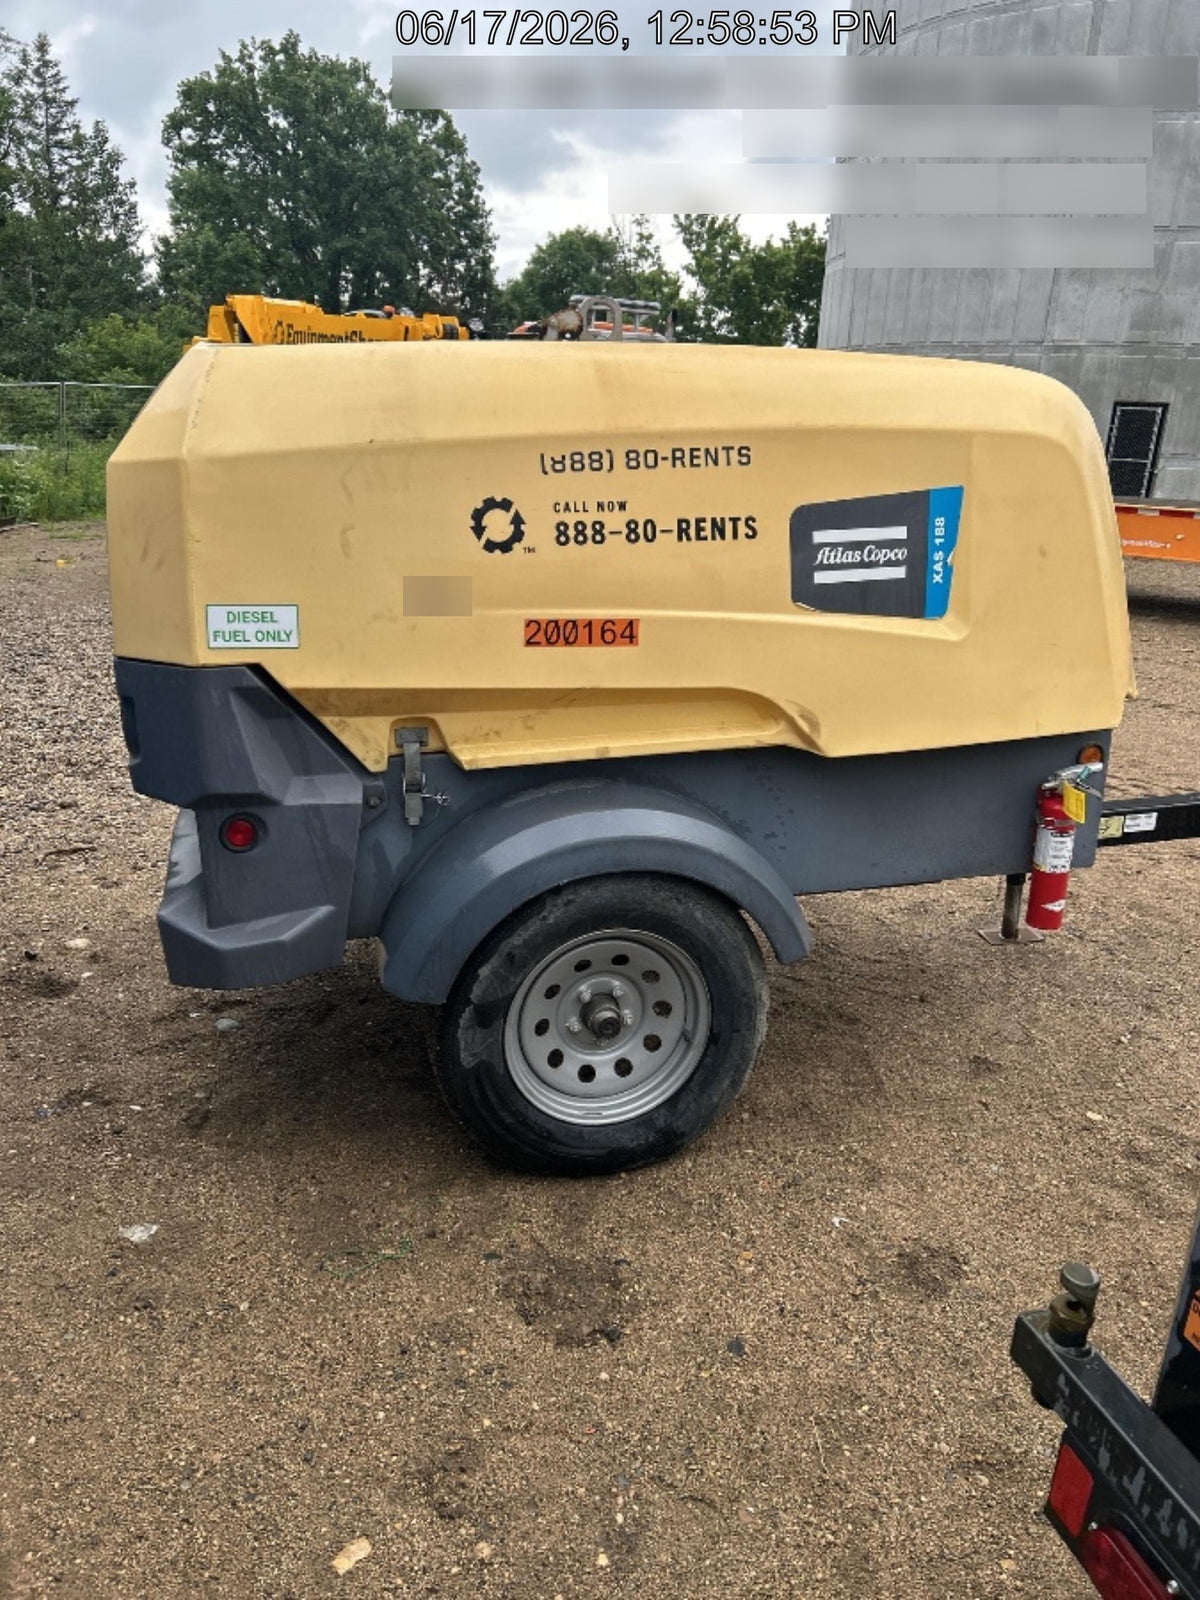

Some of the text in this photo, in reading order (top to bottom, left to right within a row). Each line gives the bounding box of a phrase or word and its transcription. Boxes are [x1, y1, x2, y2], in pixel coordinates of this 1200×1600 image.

[625, 446, 752, 470] 80-RENTS
[553, 501, 628, 513] CALL NOW
[554, 516, 759, 547] 888-80-RENTS
[815, 544, 908, 565] Atlas Copco
[933, 517, 946, 584] XAS 188
[226, 611, 277, 624] DIESEL
[213, 629, 291, 643] FUEL ONLY
[526, 620, 637, 646] 200164
